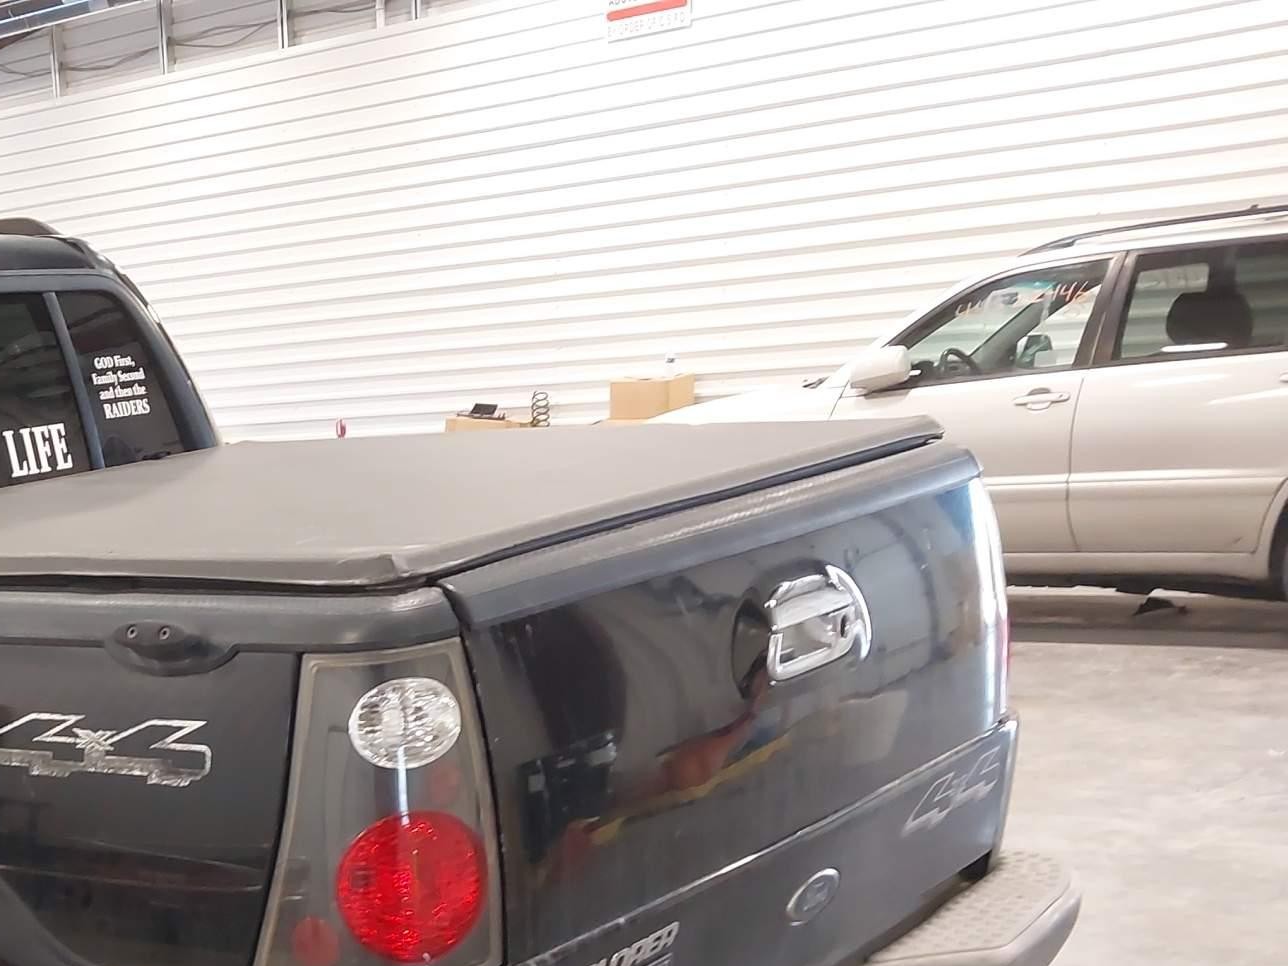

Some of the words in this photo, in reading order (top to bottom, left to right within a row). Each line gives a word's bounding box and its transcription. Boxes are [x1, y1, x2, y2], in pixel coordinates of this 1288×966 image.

[93, 356, 114, 370] GOD
[114, 355, 136, 368] First,
[91, 371, 118, 386] Family
[117, 367, 146, 383] Second
[99, 386, 115, 400] and
[115, 385, 134, 398] then
[133, 383, 148, 396] the
[103, 398, 151, 419] RAIDERS
[2, 422, 74, 478] LIFE
